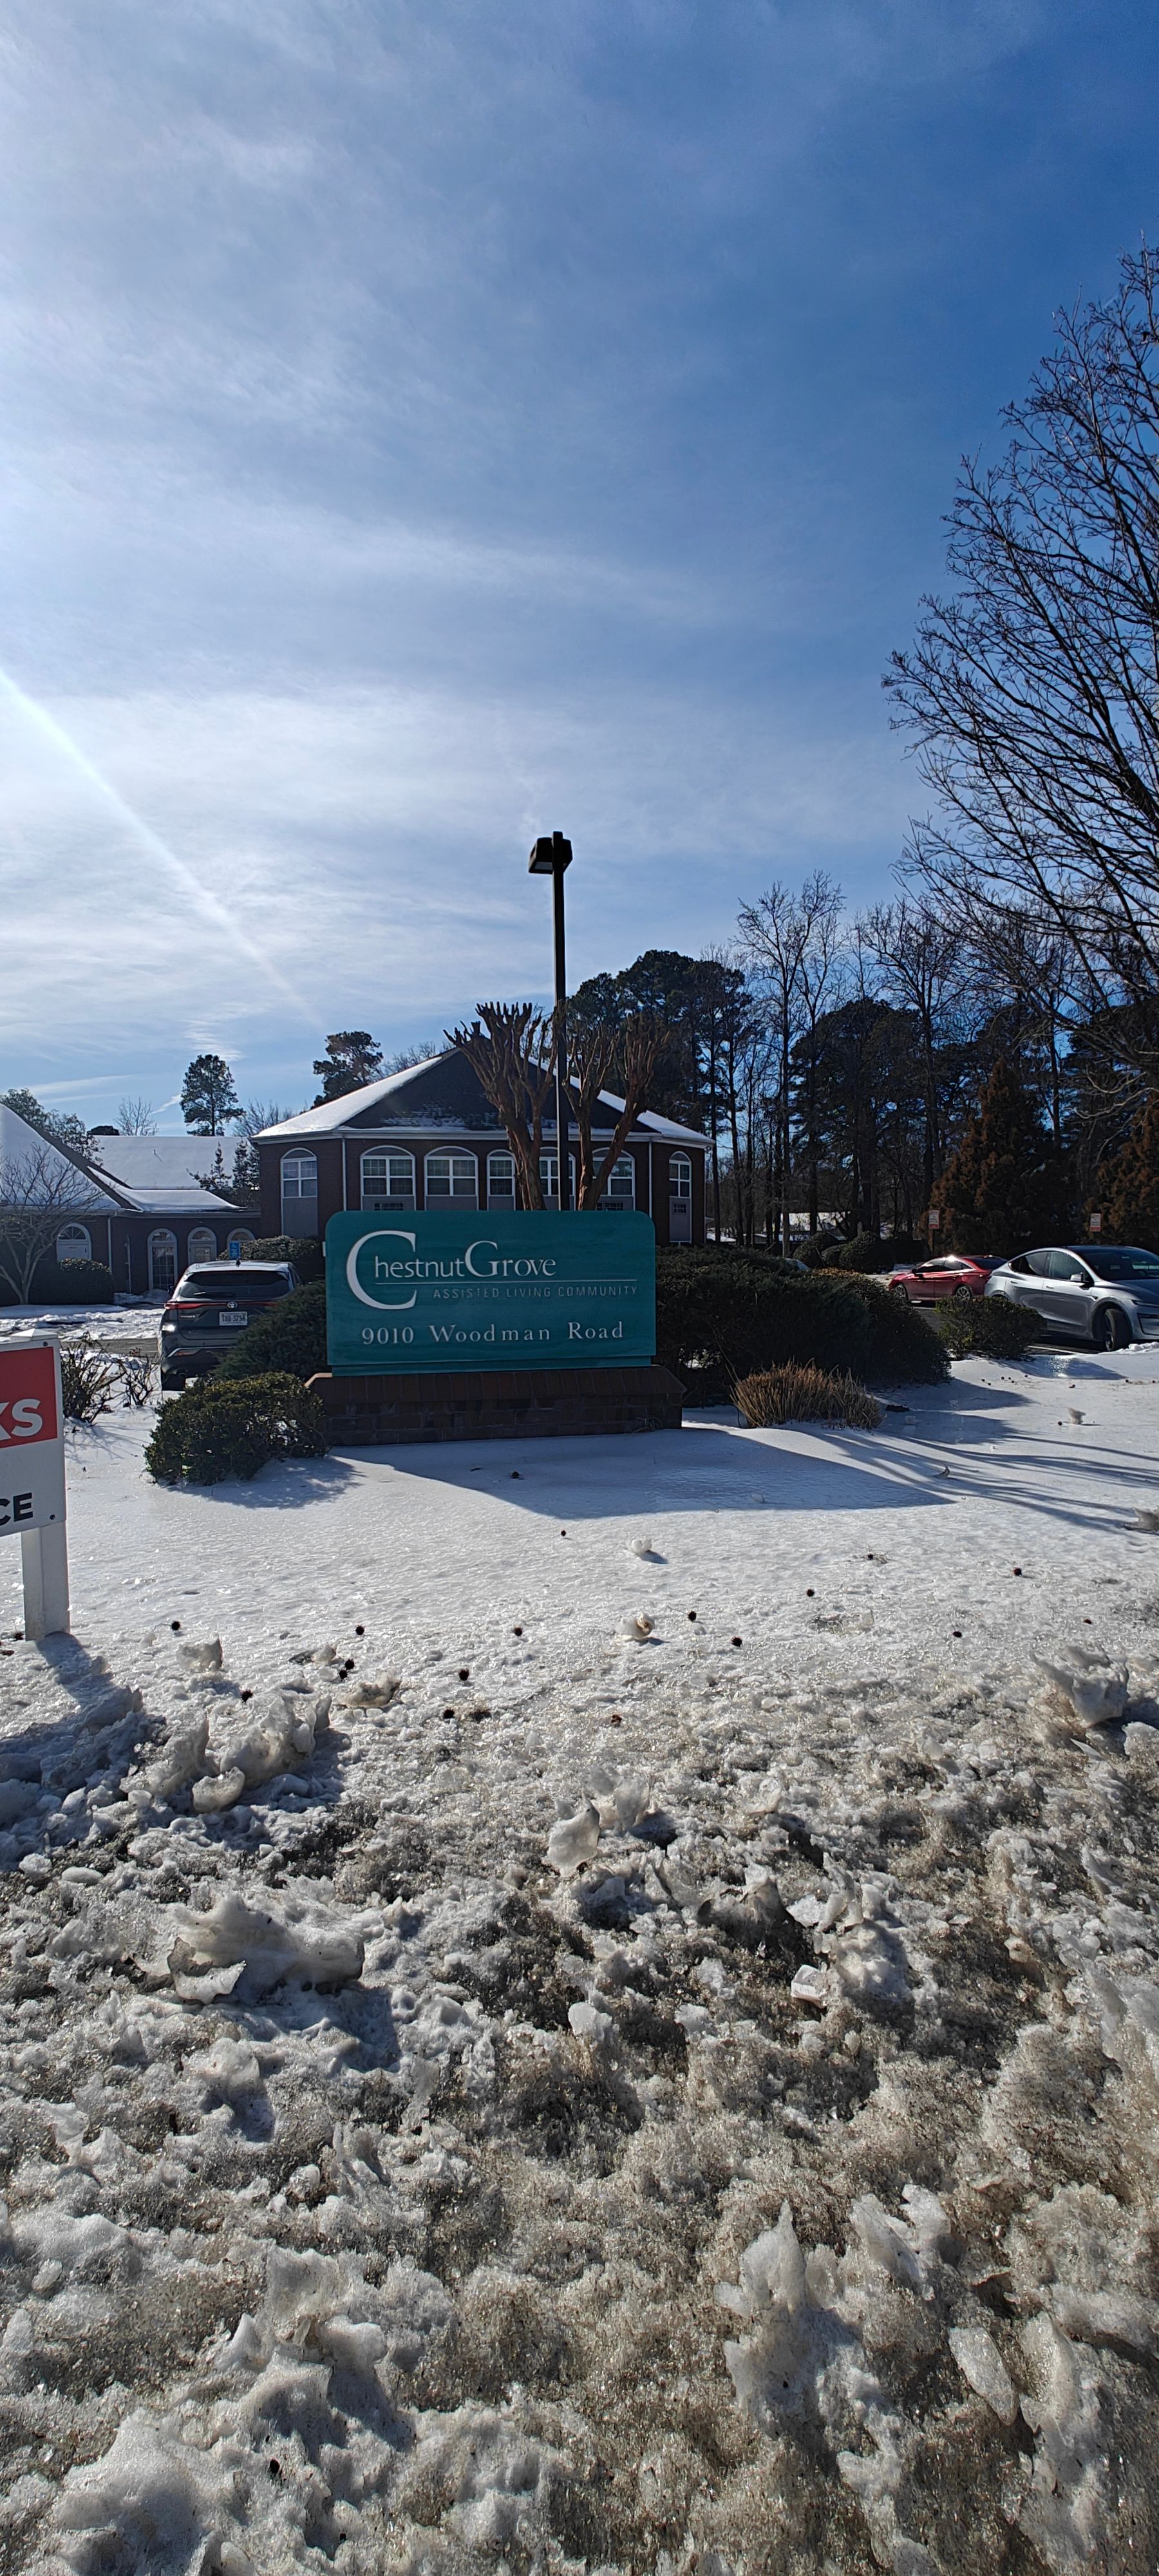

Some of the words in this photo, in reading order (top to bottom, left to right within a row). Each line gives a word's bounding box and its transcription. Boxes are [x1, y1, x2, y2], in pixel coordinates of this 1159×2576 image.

[433, 1288, 500, 1299] ASSISTED
[507, 1287, 551, 1298] LIVING
[558, 1286, 637, 1297] COMMUNITY
[362, 1327, 414, 1345] 9010
[429, 1324, 550, 1342] Woodman
[567, 1321, 623, 1340] Road
